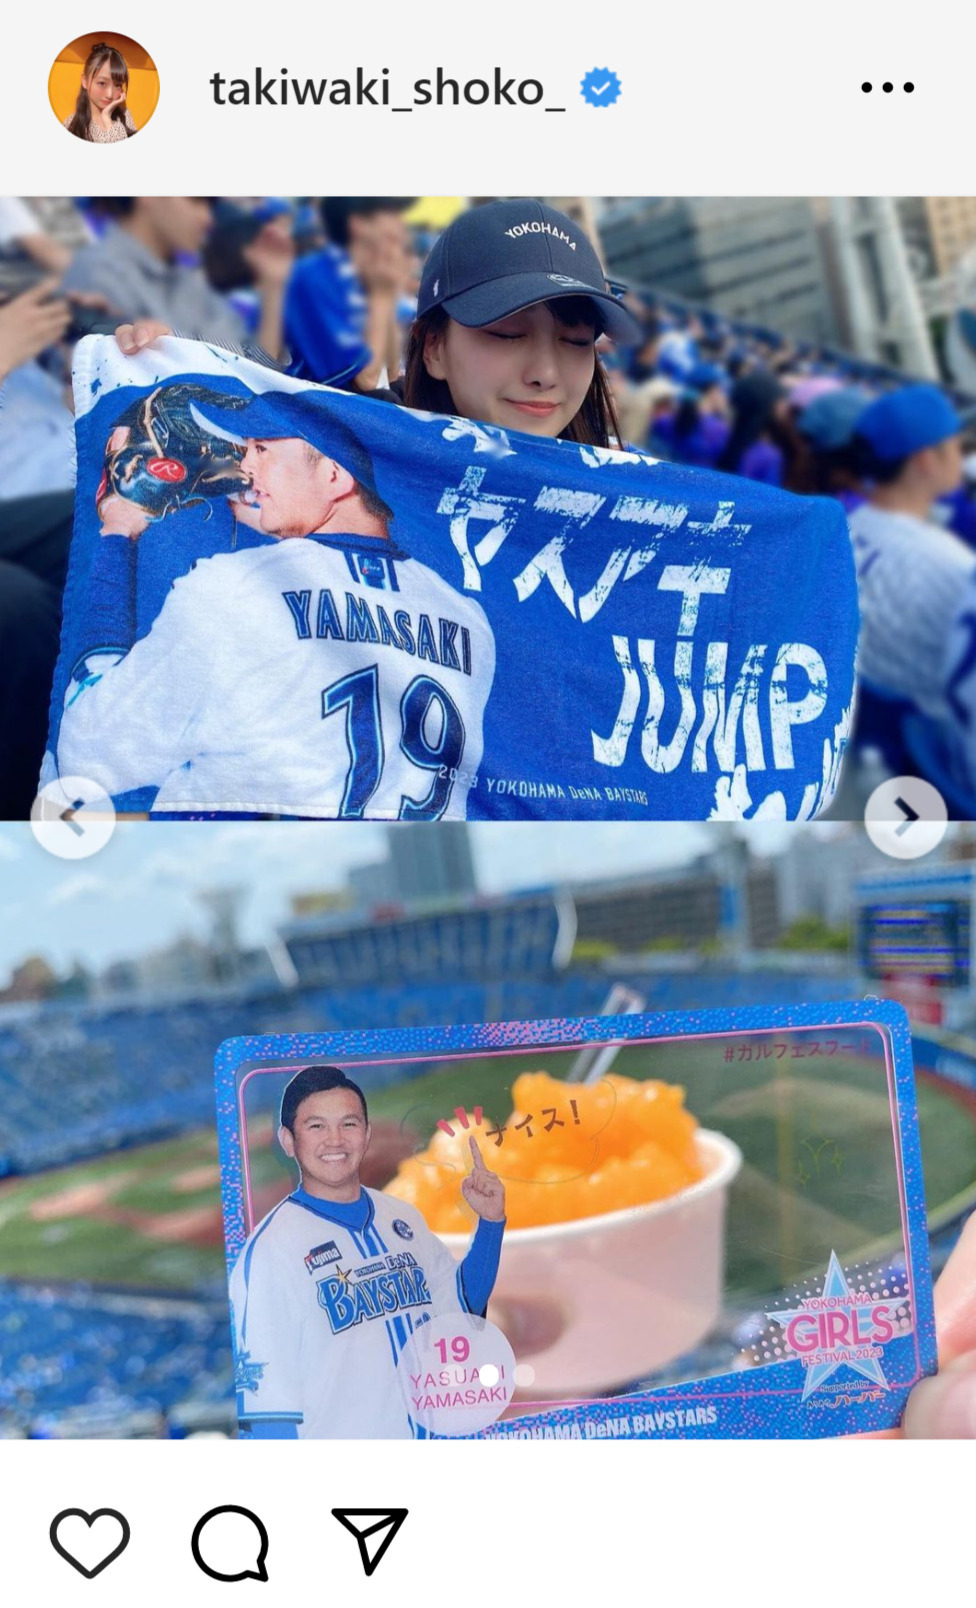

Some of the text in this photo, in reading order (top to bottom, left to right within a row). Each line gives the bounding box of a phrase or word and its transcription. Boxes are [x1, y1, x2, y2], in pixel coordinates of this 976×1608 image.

[504, 221, 577, 251] YOKOHAMA
[281, 588, 472, 677] YAMASAKI
[590, 634, 828, 774] JUMP
[321, 663, 466, 821] 19
[439, 763, 649, 806] 2023 YOKOHAMA DeNA BAYSTARS
[316, 1266, 432, 1335] BAYSTAR
[804, 1294, 872, 1311] YOKOHAMA
[787, 1306, 893, 1352] GIRLS
[434, 1336, 470, 1364] 19
[802, 1346, 883, 1366] FESTIVAL 2023
[410, 1364, 505, 1389] YASUAI
[411, 1386, 507, 1410] YAMASAKI
[584, 1415, 632, 1439] DeNA
[633, 1405, 718, 1434] BAYSTARS
